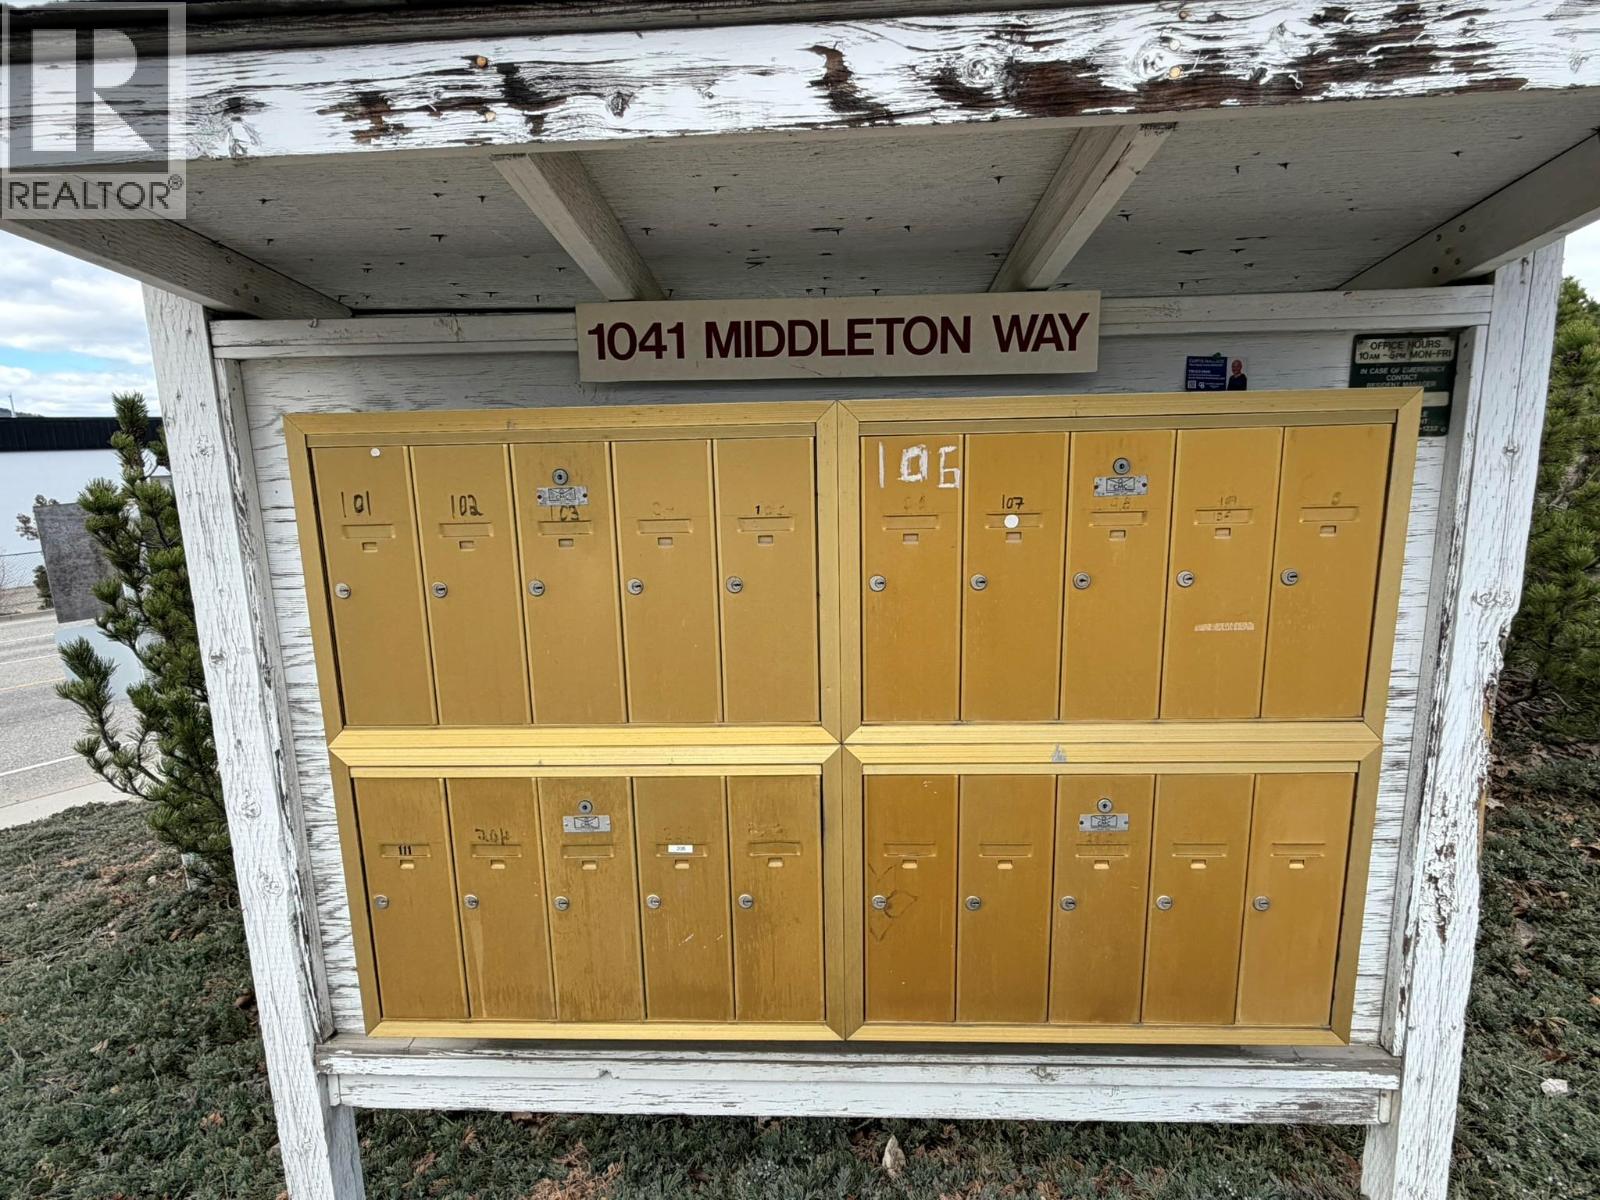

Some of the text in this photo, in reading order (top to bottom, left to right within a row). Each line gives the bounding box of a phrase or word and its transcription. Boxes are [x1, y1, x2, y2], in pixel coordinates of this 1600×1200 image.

[588, 312, 1090, 361] 1041 MIDDLETON WAY
[1370, 340, 1441, 350] OFFICE HOURS
[1409, 349, 1452, 359] MON-FRI
[879, 441, 960, 488] 106
[341, 490, 371, 518] 101
[450, 494, 483, 519] 102
[1002, 494, 1024, 509] 107
[399, 845, 412, 856] 111
